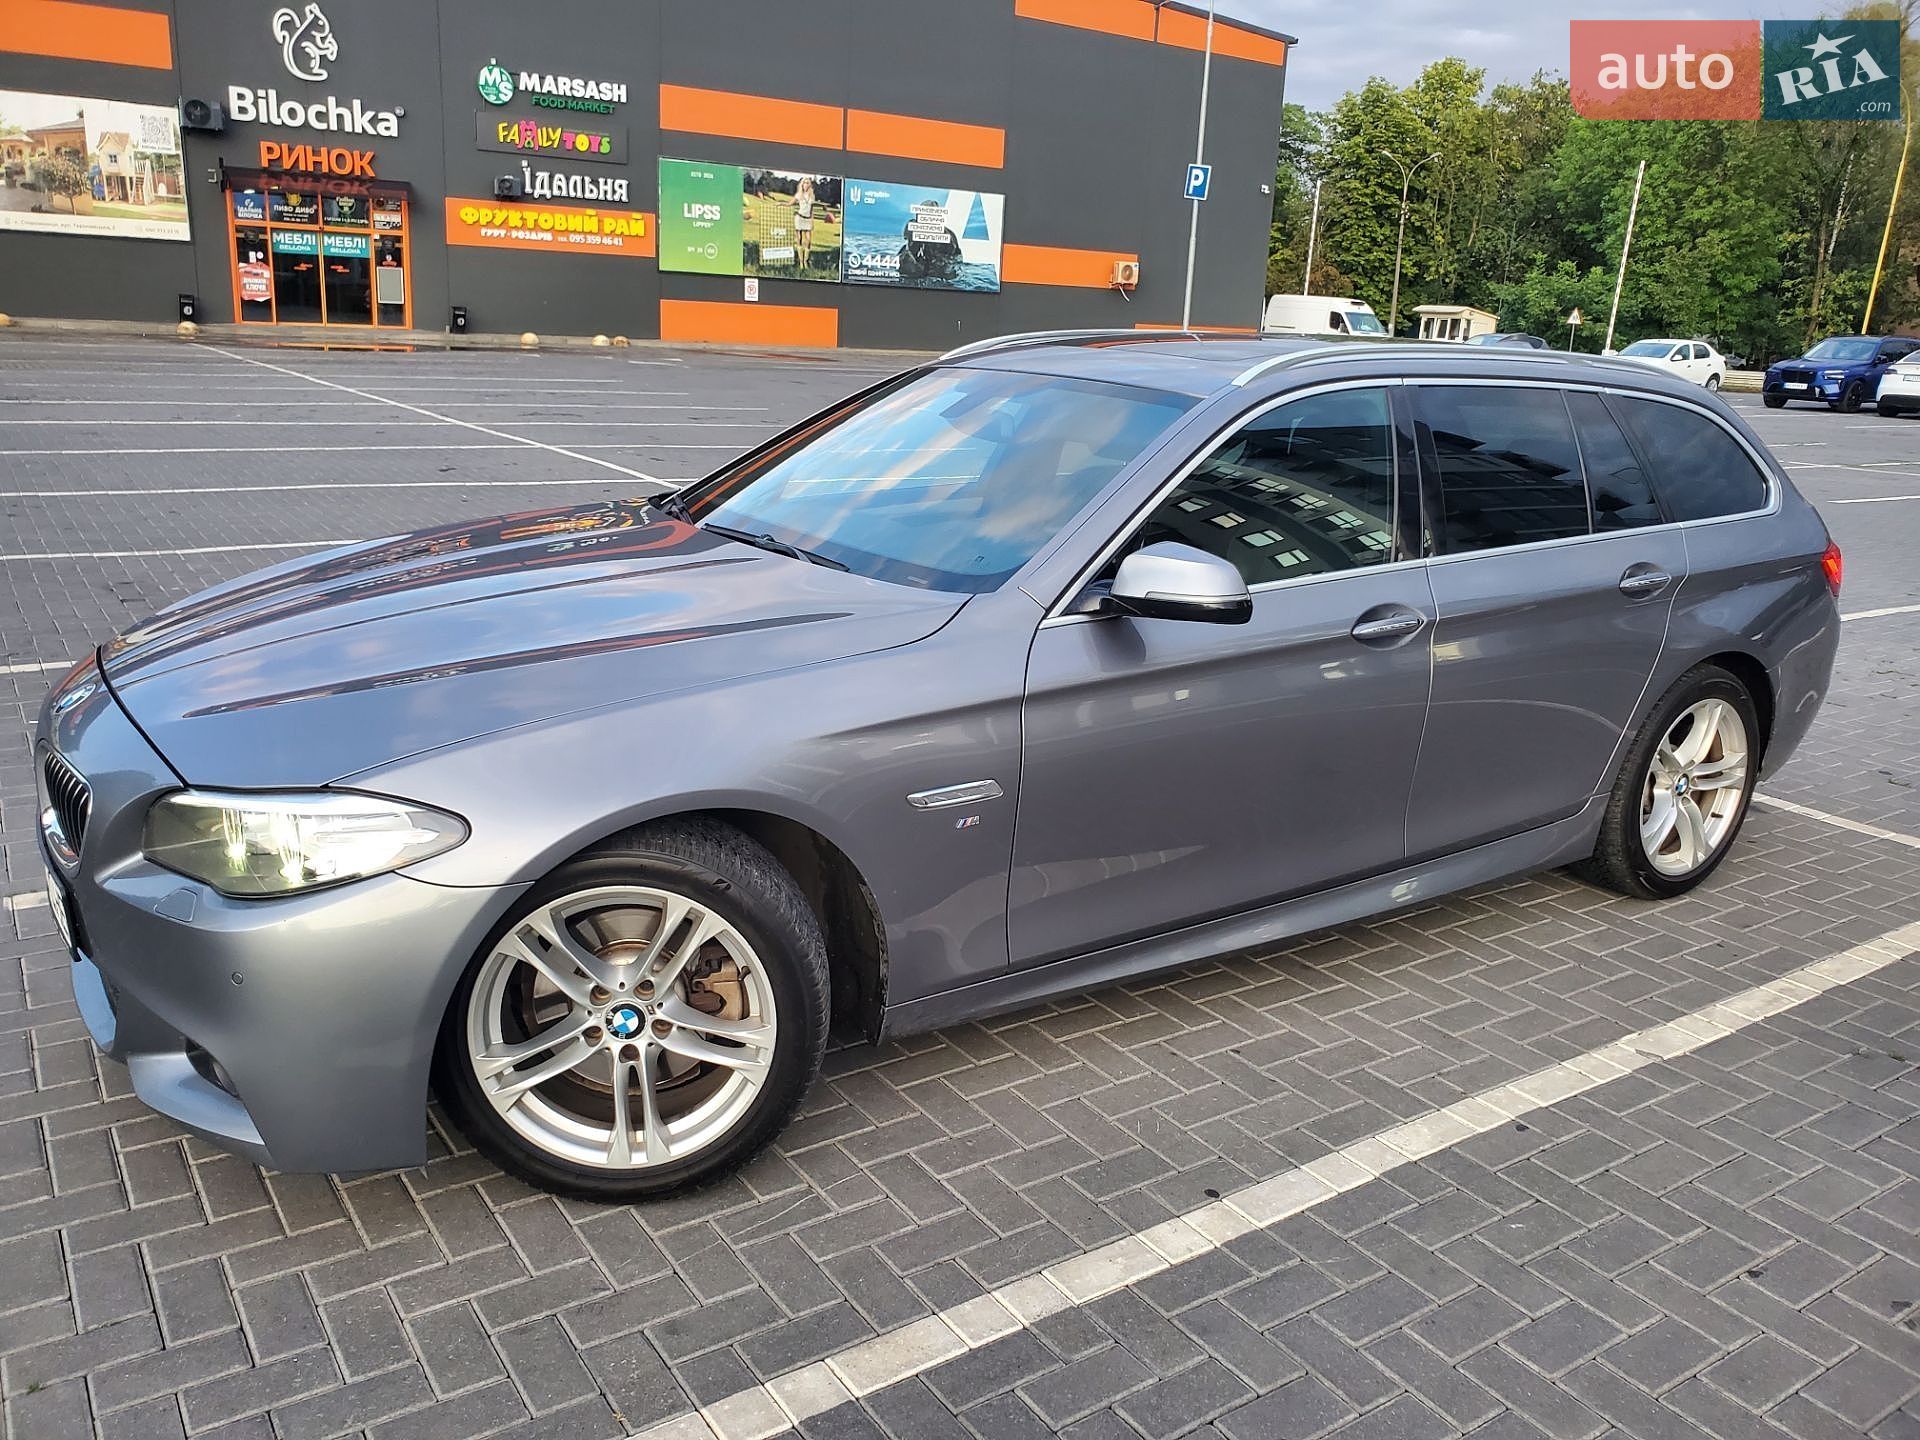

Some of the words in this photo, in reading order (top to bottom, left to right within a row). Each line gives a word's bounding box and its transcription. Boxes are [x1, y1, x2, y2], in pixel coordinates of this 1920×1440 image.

[519, 71, 627, 103] MARSASH
[228, 85, 399, 137] Bilochka
[532, 95, 566, 109] FOOD
[567, 99, 616, 114] MARKET
[498, 120, 562, 151] FAMILY
[562, 131, 611, 154] TOYS
[260, 140, 376, 177] РИНОК
[1188, 168, 1204, 194] P
[459, 206, 599, 233] ФРУКТОВИЙ
[603, 213, 646, 236] РАЙ
[683, 202, 721, 220] LIPSS
[272, 232, 316, 245] МЕБЛІ
[323, 235, 366, 248] МЕБЛІ
[569, 233, 586, 244] 095
[586, 234, 602, 245] 359
[861, 254, 900, 270] 4444
